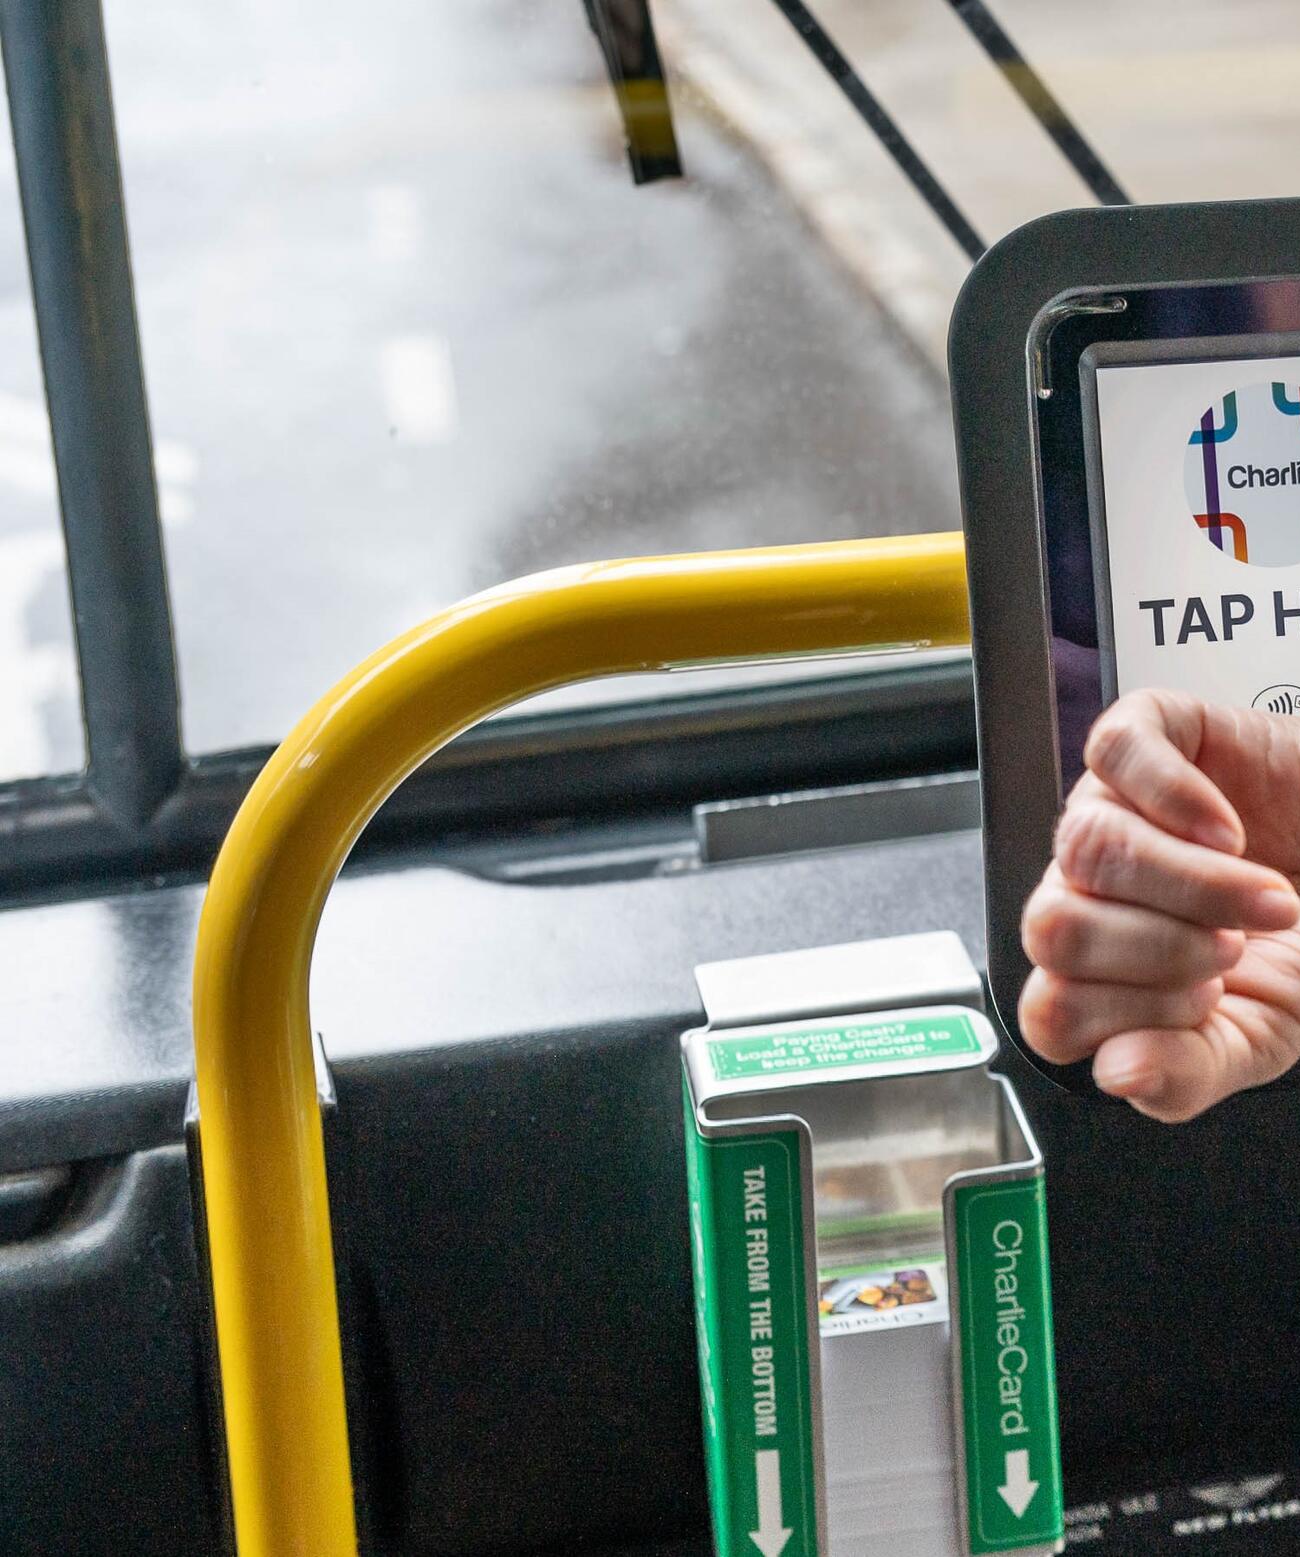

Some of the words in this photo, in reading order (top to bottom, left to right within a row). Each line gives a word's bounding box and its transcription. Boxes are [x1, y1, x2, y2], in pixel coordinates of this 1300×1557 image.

[1139, 593, 1255, 646] TAP
[736, 1046, 787, 1062] Load
[792, 1044, 805, 1056] a
[809, 1031, 926, 1053] CharlieCard
[930, 1029, 951, 1041] to
[761, 1054, 811, 1070] keep
[816, 1048, 848, 1063] the
[853, 1044, 932, 1060] change.
[773, 1030, 840, 1048] Paying
[846, 1023, 907, 1039] Cash?
[742, 1165, 768, 1223] TAKE
[745, 1228, 770, 1292] FROM
[749, 1298, 773, 1341] THE
[992, 1219, 1030, 1436] CharlieCard
[750, 1346, 778, 1436] BOTTOM
